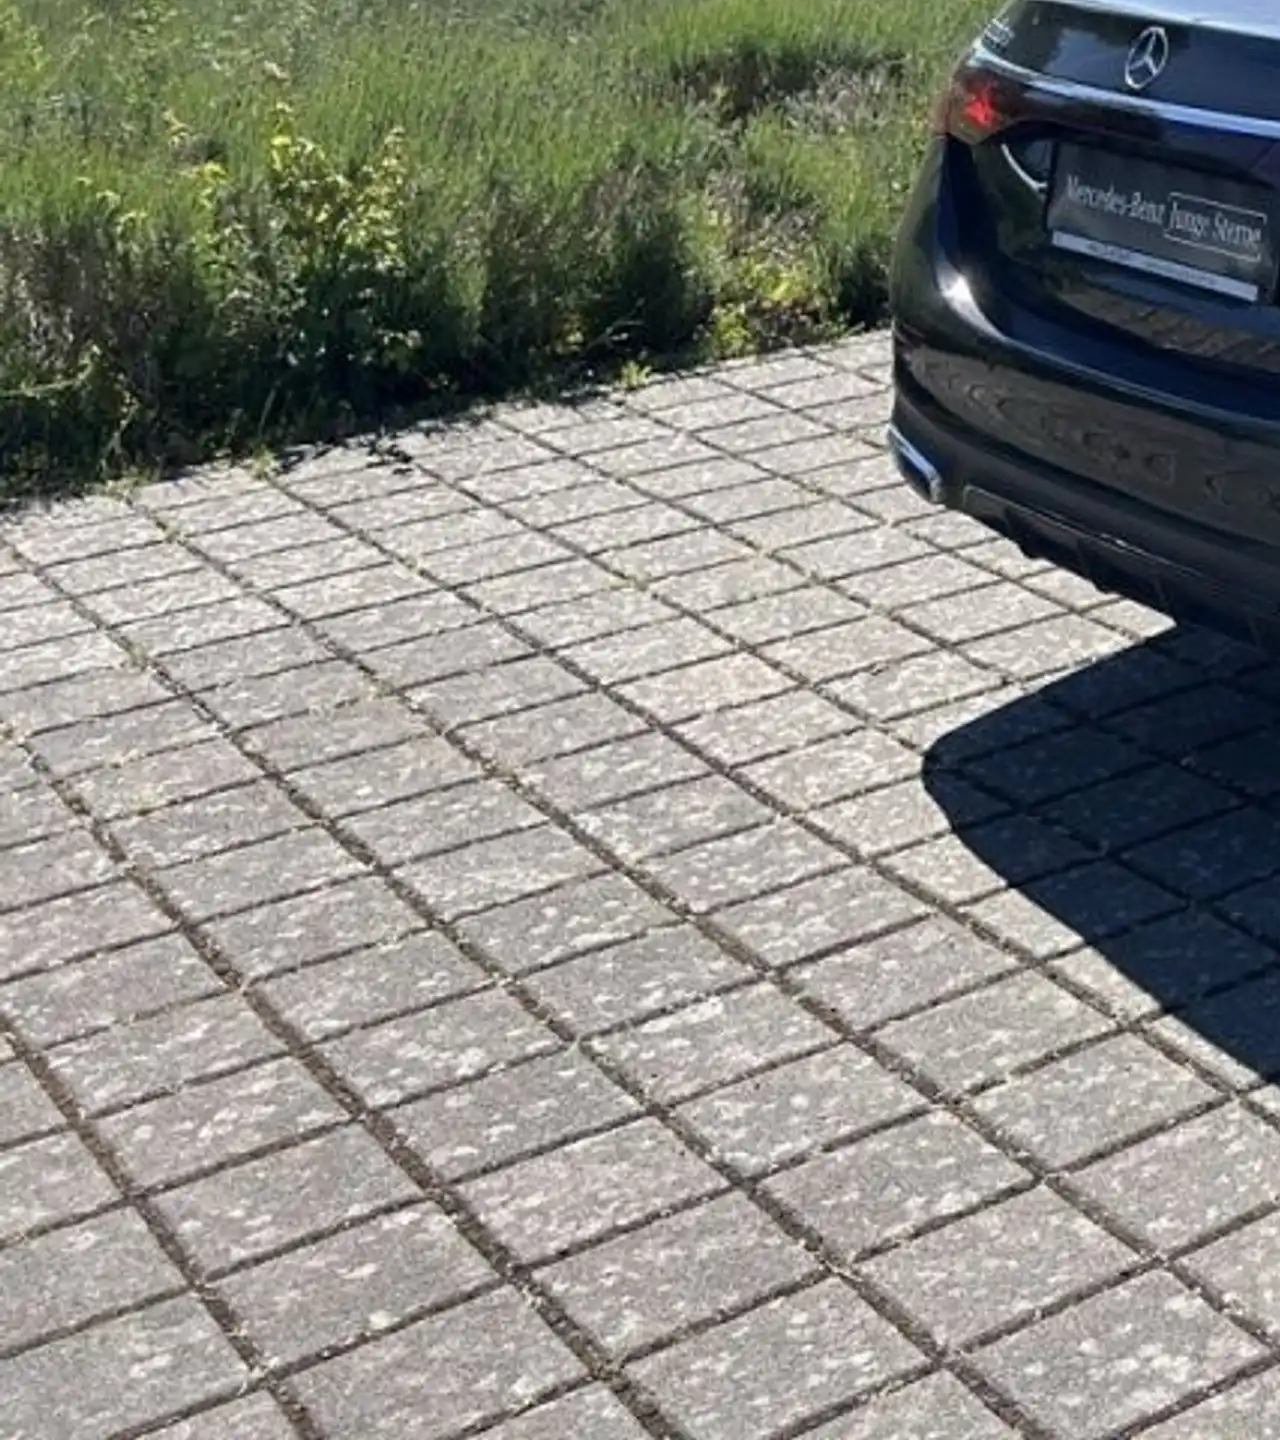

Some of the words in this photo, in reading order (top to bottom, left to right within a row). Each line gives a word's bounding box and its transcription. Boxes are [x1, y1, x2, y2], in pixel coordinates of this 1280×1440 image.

[1067, 174, 1166, 225] Mercedes-Benz
[1168, 201, 1210, 240] Junge
[1213, 211, 1262, 248] Sterne
